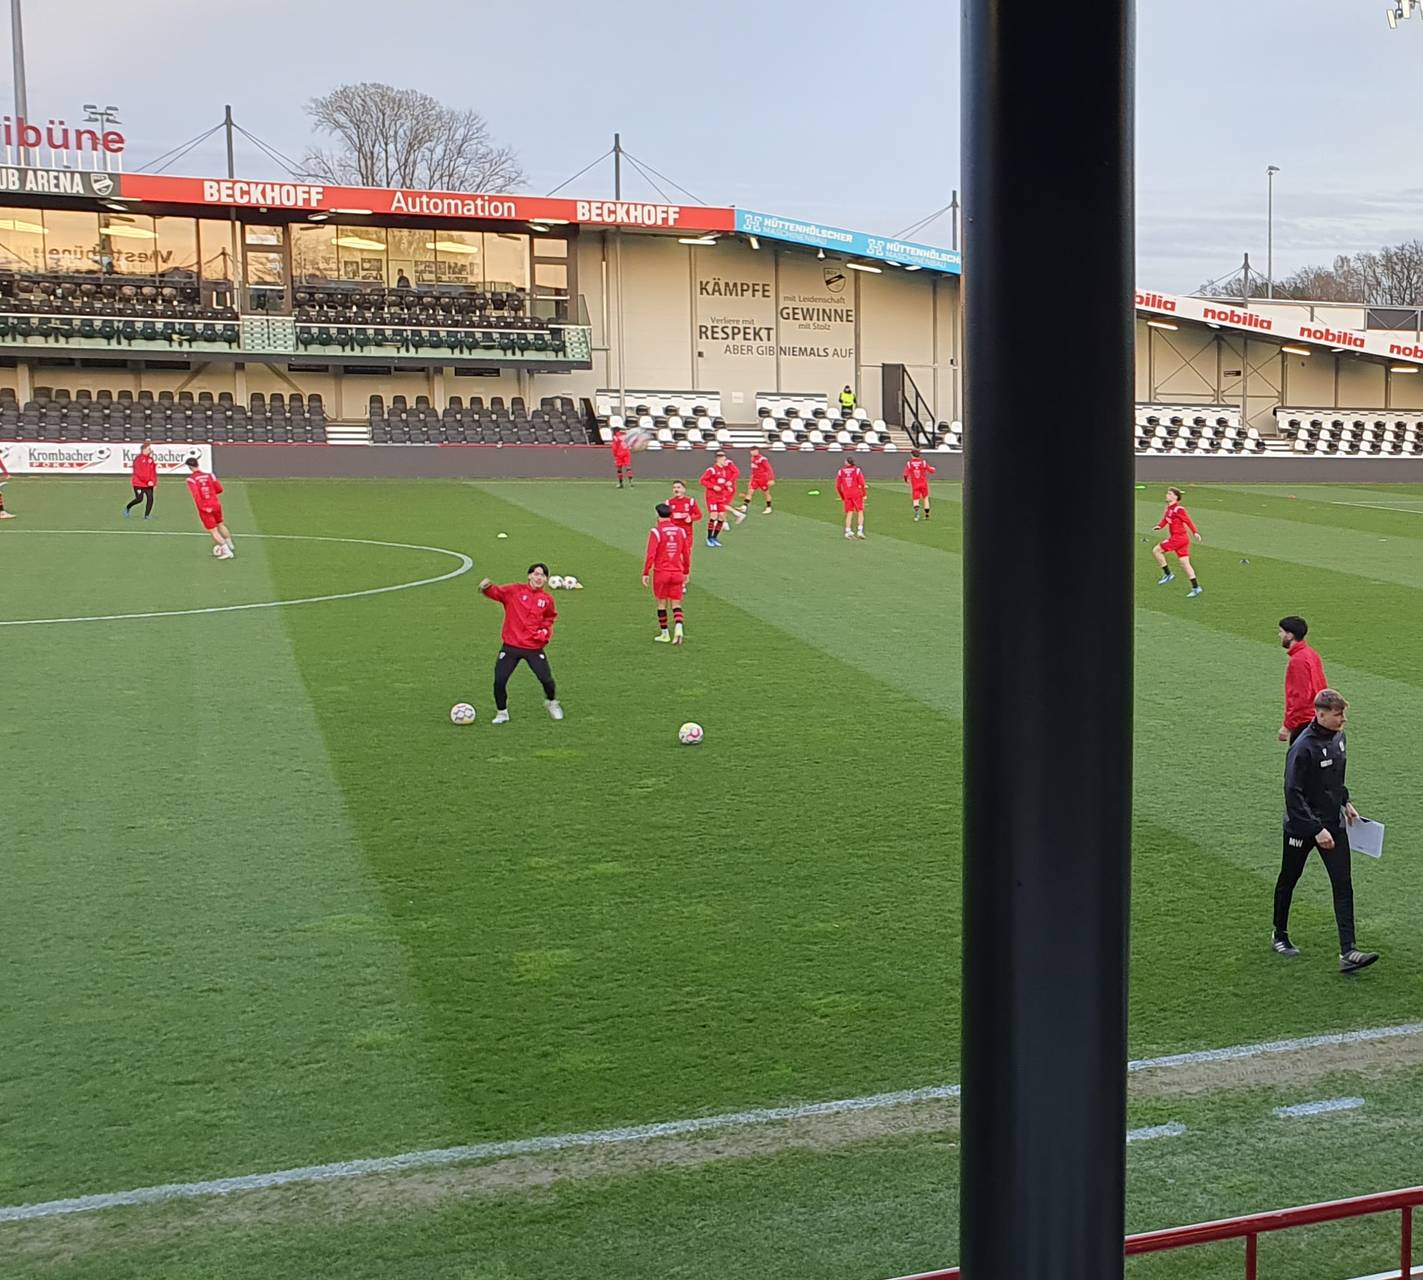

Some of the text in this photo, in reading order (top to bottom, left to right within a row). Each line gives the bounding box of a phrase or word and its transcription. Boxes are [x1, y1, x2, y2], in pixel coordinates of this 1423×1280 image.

[25, 171, 84, 194] ARENA
[203, 180, 515, 217] BECKHOFF Automation
[576, 201, 680, 226] BECKHOFF
[763, 217, 853, 243] HÜTTENHÖLSCHER
[699, 277, 771, 298] KÄMPFE
[783, 295, 846, 304] mit Leidenschaft
[710, 316, 741, 325] Verliere
[779, 306, 854, 323] GEWINNE
[1203, 306, 1273, 331] nobilia
[698, 325, 774, 342] RESPEKT
[812, 323, 831, 331] Stolz
[1299, 325, 1365, 349] nobilia
[724, 344, 854, 358] ABER GIB NIEMALS AUF
[29, 448, 94, 462] Krombacher
[122, 448, 185, 462] Krbacher
[1288, 837, 1304, 848] MW
